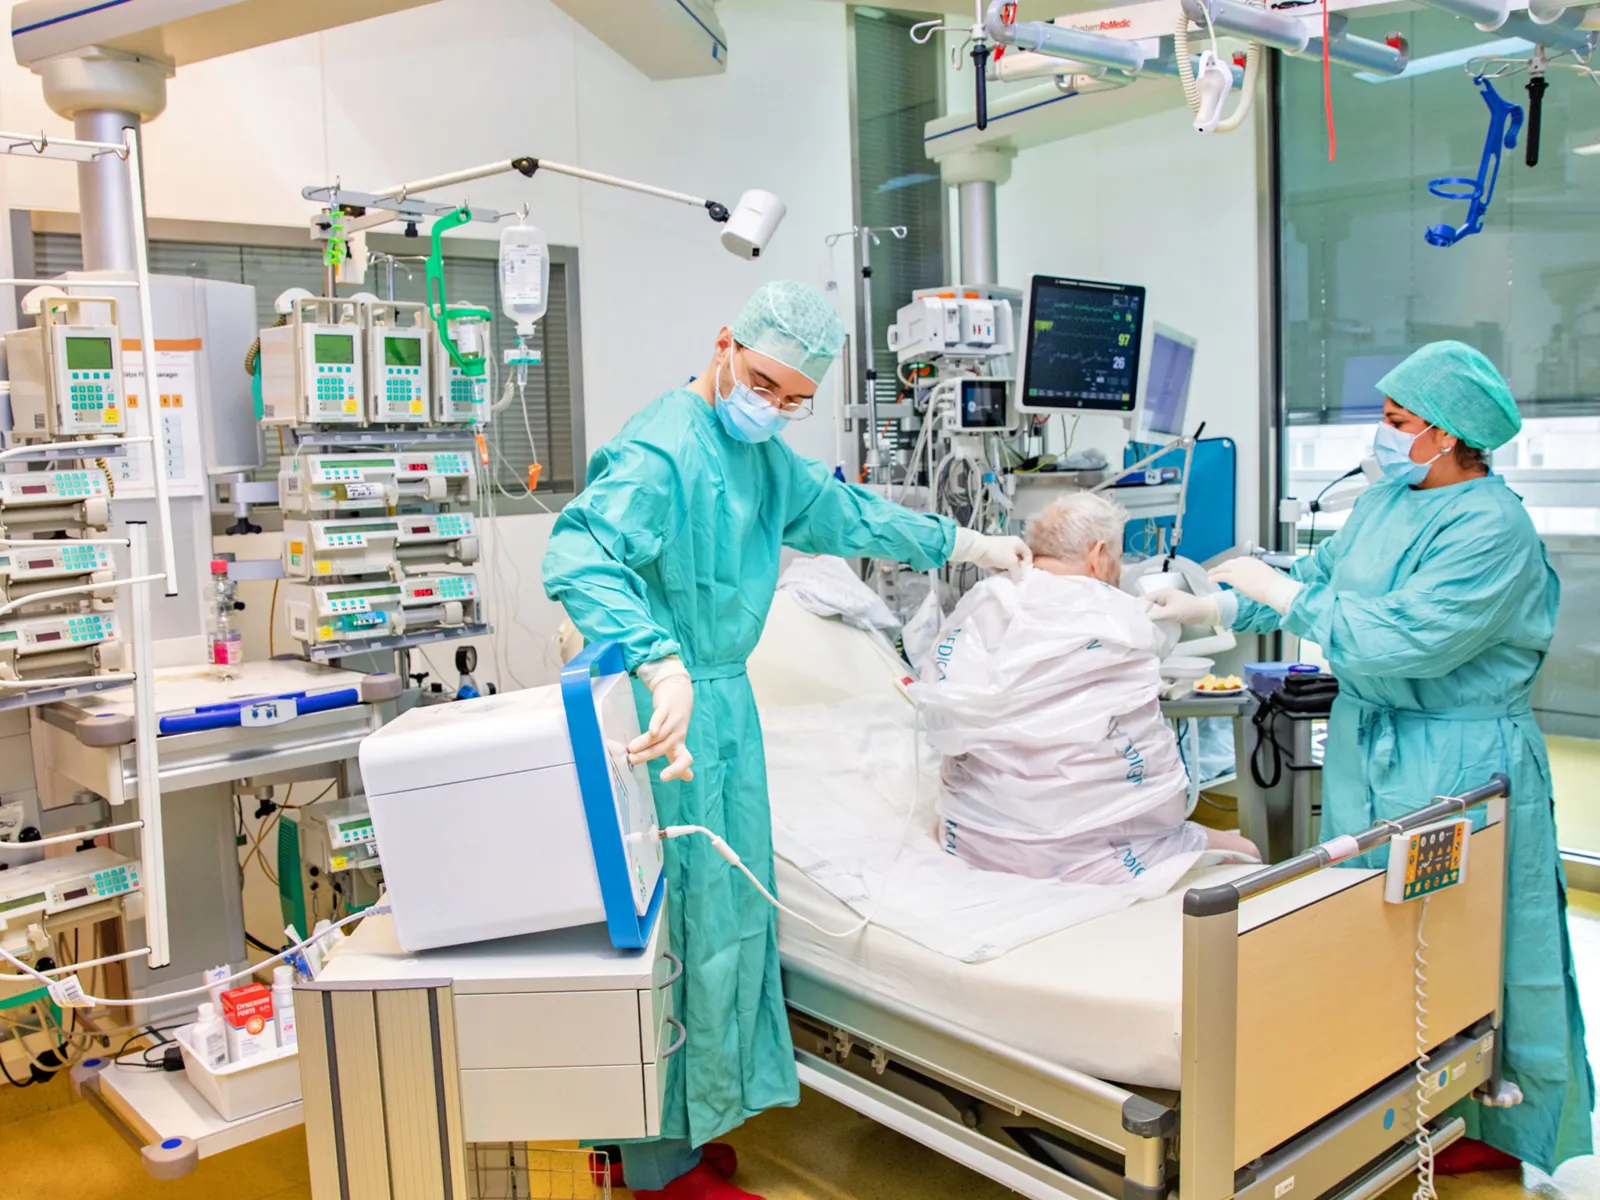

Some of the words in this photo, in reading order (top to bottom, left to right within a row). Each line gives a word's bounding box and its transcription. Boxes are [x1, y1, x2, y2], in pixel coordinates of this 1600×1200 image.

[1118, 333, 1131, 347] 97
[1112, 355, 1126, 370] 26
[121, 461, 129, 469] 26
[122, 471, 130, 479] 25
